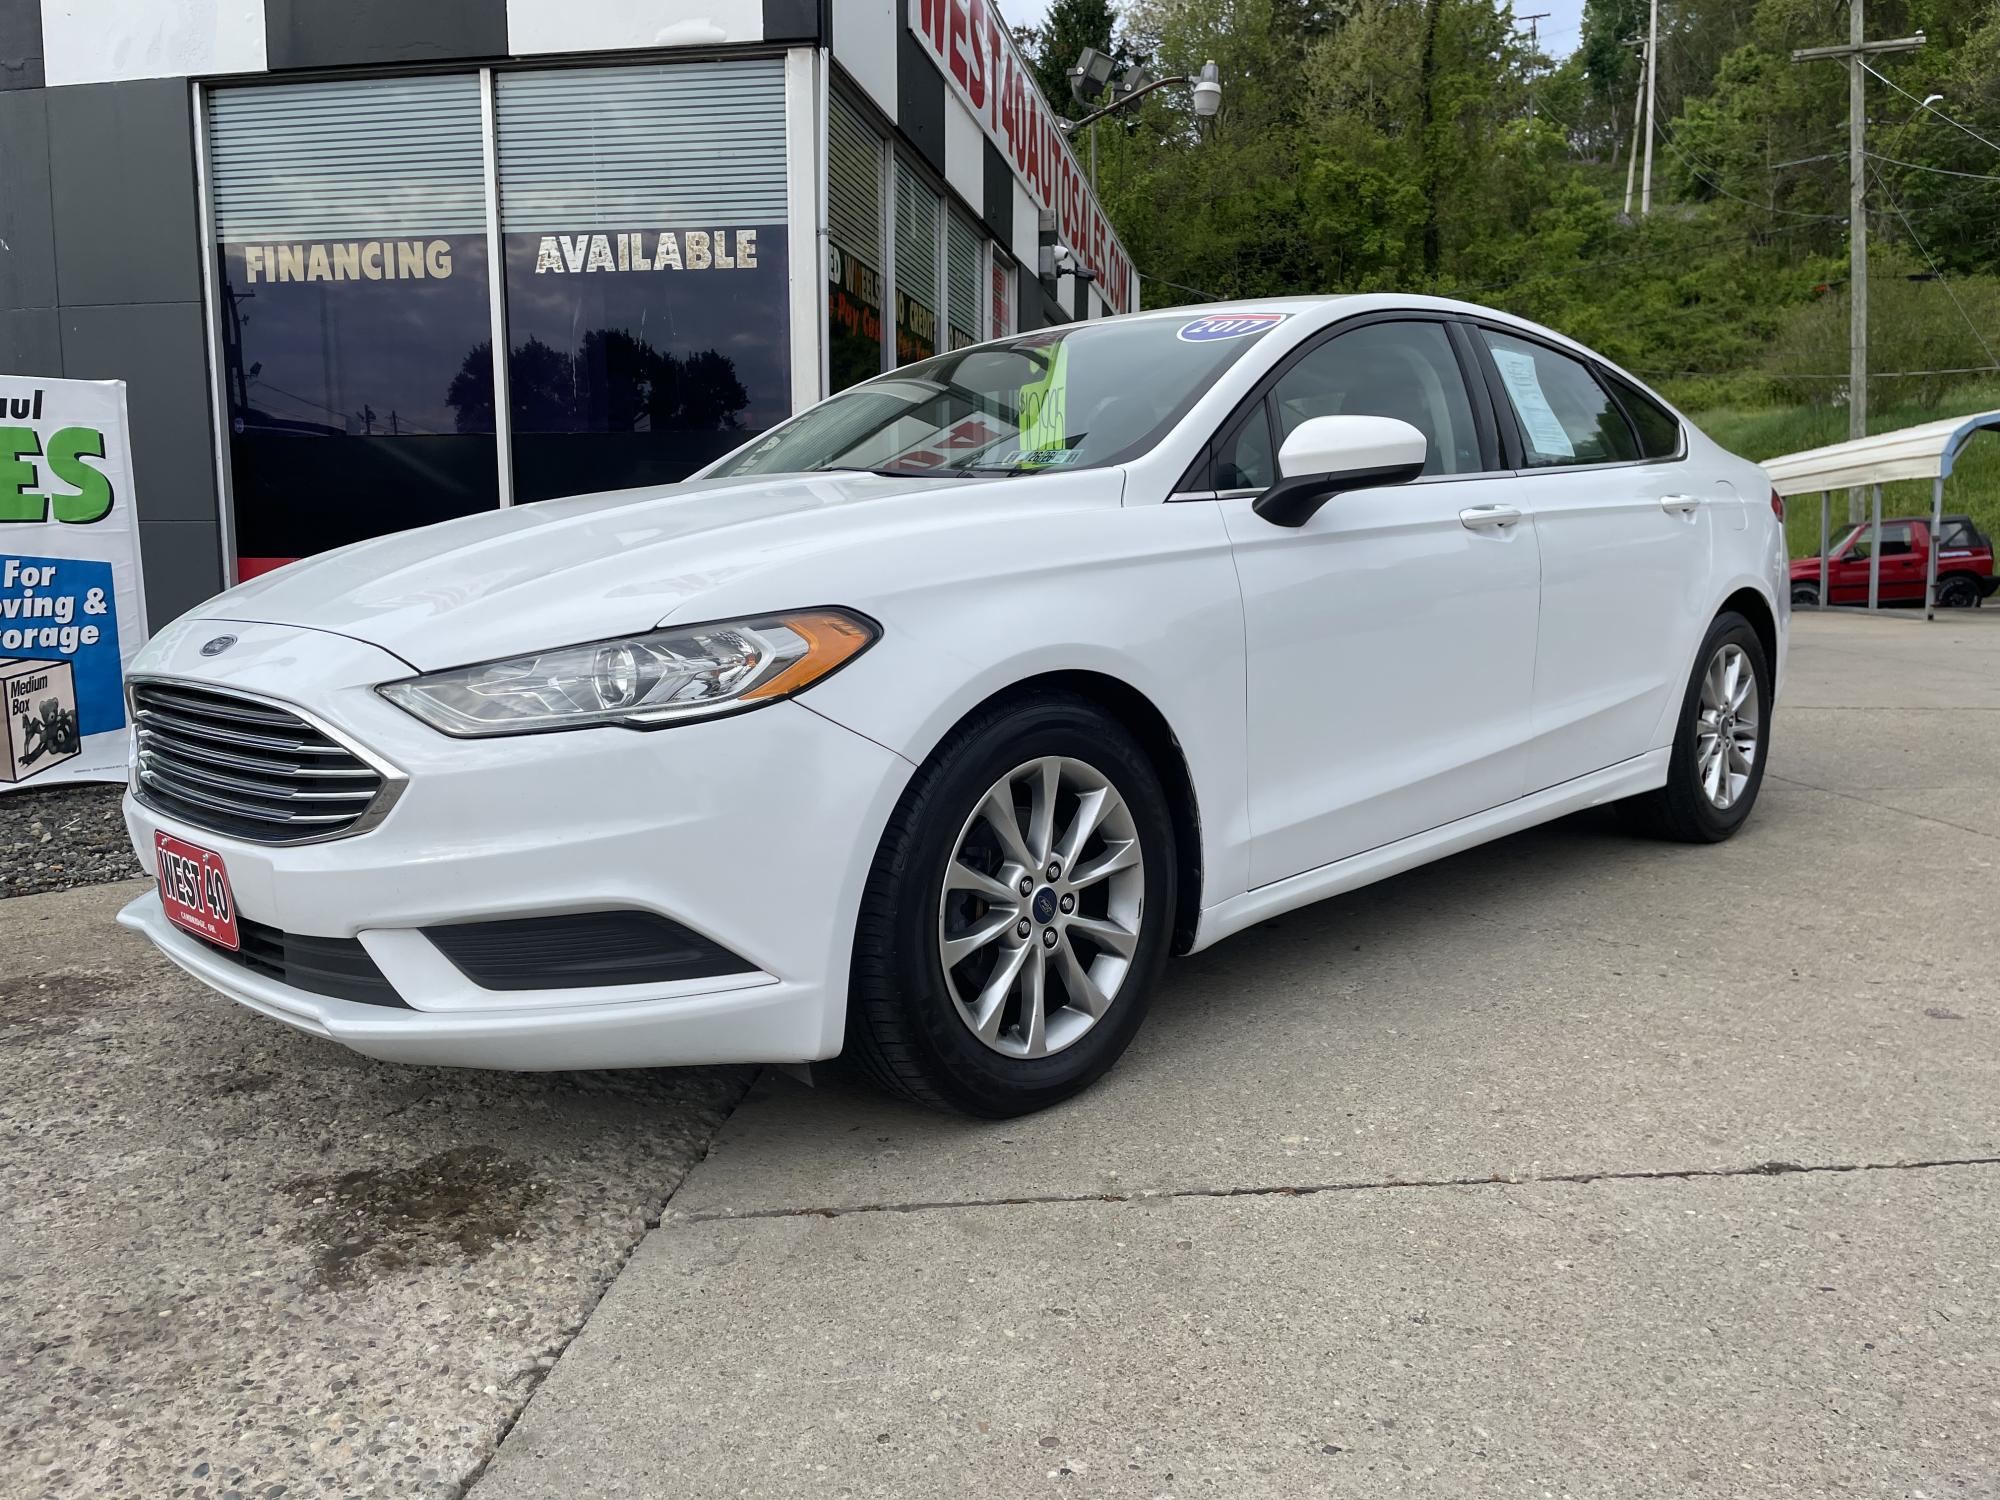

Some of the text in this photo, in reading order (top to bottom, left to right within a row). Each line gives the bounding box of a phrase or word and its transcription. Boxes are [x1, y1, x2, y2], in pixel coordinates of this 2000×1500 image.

[245, 229, 758, 283] FINANCING AVAILABLE
[1185, 320, 1268, 333] 2017
[3, 560, 56, 588] For
[0, 587, 108, 624] ving &
[0, 625, 100, 654] orage
[11, 675, 48, 698] Medium
[12, 698, 30, 716] Box
[157, 846, 230, 924] WEST 40
